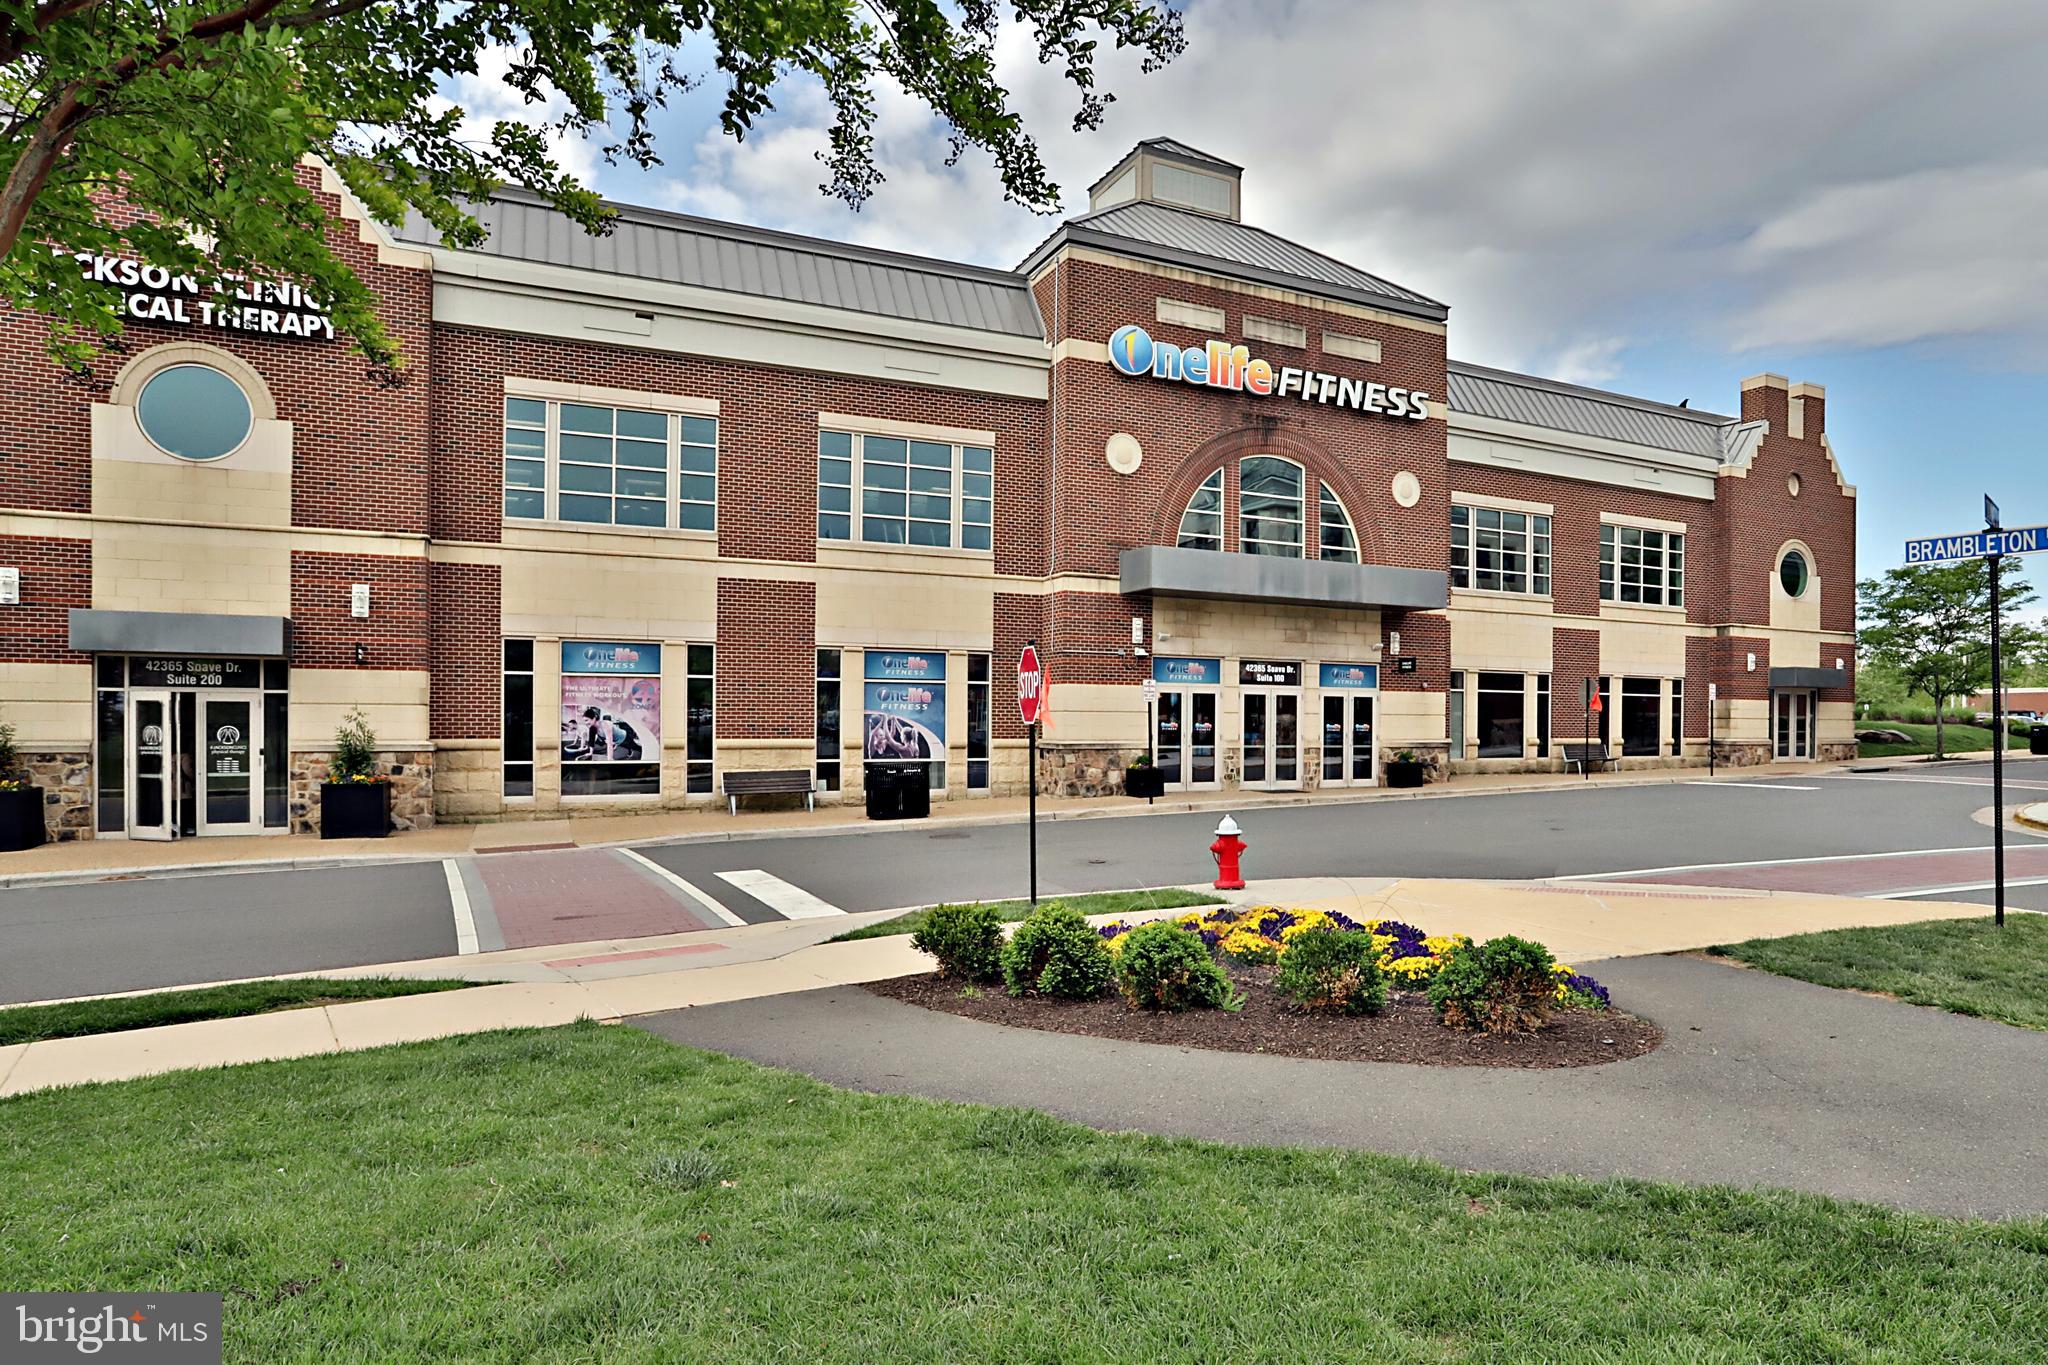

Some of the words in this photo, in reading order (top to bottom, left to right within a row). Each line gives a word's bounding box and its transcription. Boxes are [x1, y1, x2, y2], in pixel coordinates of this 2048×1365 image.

[53, 249, 199, 293] CKSON
[212, 272, 333, 311] CLINIC
[198, 301, 335, 339] THERAPY
[1107, 324, 1274, 395] Onelife
[1277, 366, 1430, 420] FITNESS
[1908, 529, 2037, 562] BRAMBLETON
[145, 661, 183, 671] 42365
[187, 662, 222, 672] Soave
[225, 663, 242, 673] Dr.
[166, 673, 197, 685] Suite
[200, 674, 222, 685] 200
[1273, 674, 1285, 683] 100
[1020, 671, 1039, 699] STOP
[881, 703, 928, 711] FITNESS
